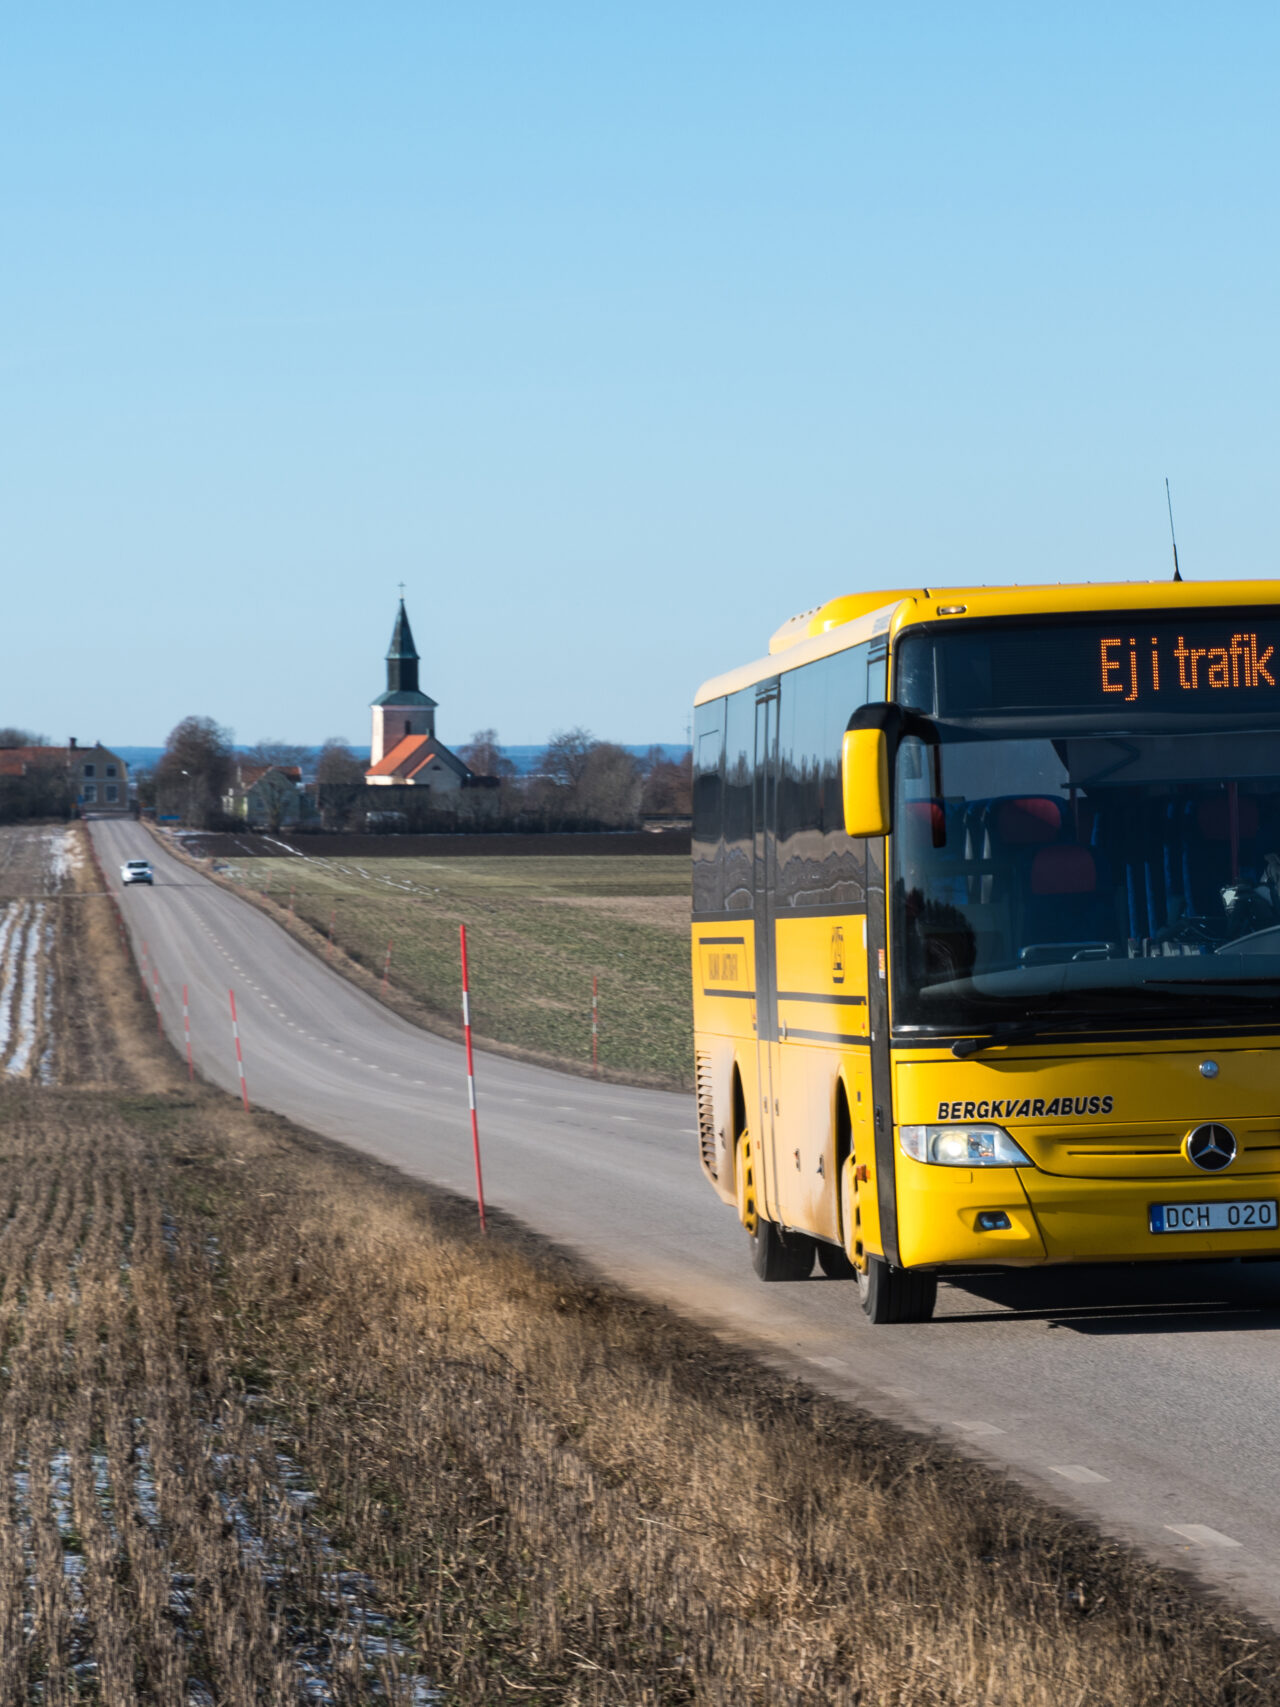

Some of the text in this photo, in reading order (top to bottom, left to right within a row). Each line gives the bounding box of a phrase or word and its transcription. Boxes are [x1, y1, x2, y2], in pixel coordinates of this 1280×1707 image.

[1101, 633, 1276, 701] Ej i trafik
[936, 1095, 1114, 1120] BERGKVARABUSS
[1166, 1204, 1271, 1228] DCH 020
